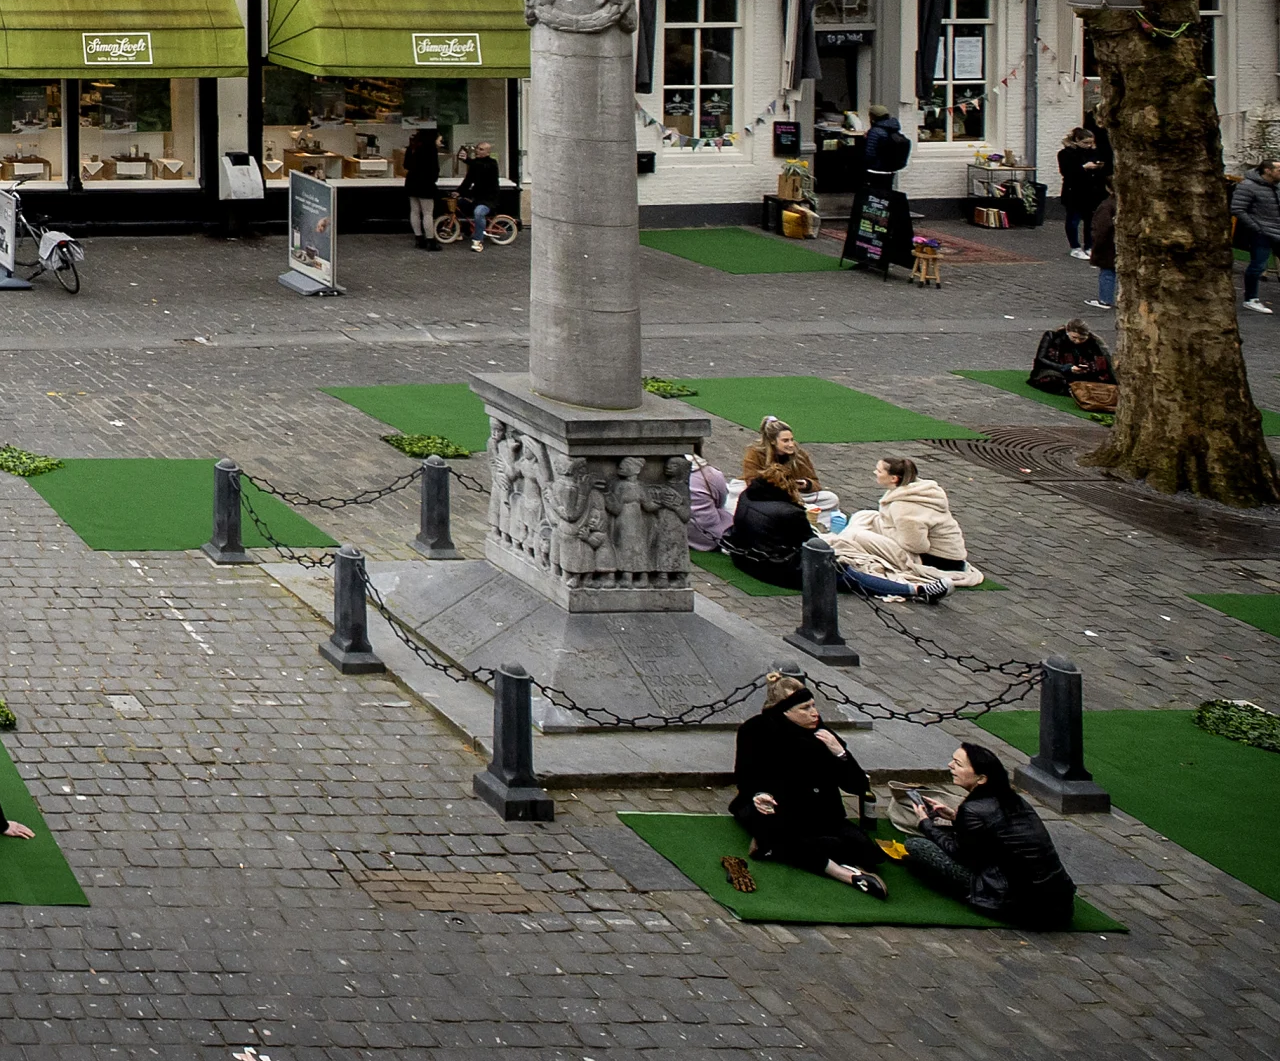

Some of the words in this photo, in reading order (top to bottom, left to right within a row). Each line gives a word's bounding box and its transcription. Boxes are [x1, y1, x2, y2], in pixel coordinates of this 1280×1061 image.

[87, 38, 119, 53] Simon
[114, 38, 146, 56] Lévelt
[417, 38, 449, 53] Simon
[444, 38, 475, 57] Lévelt
